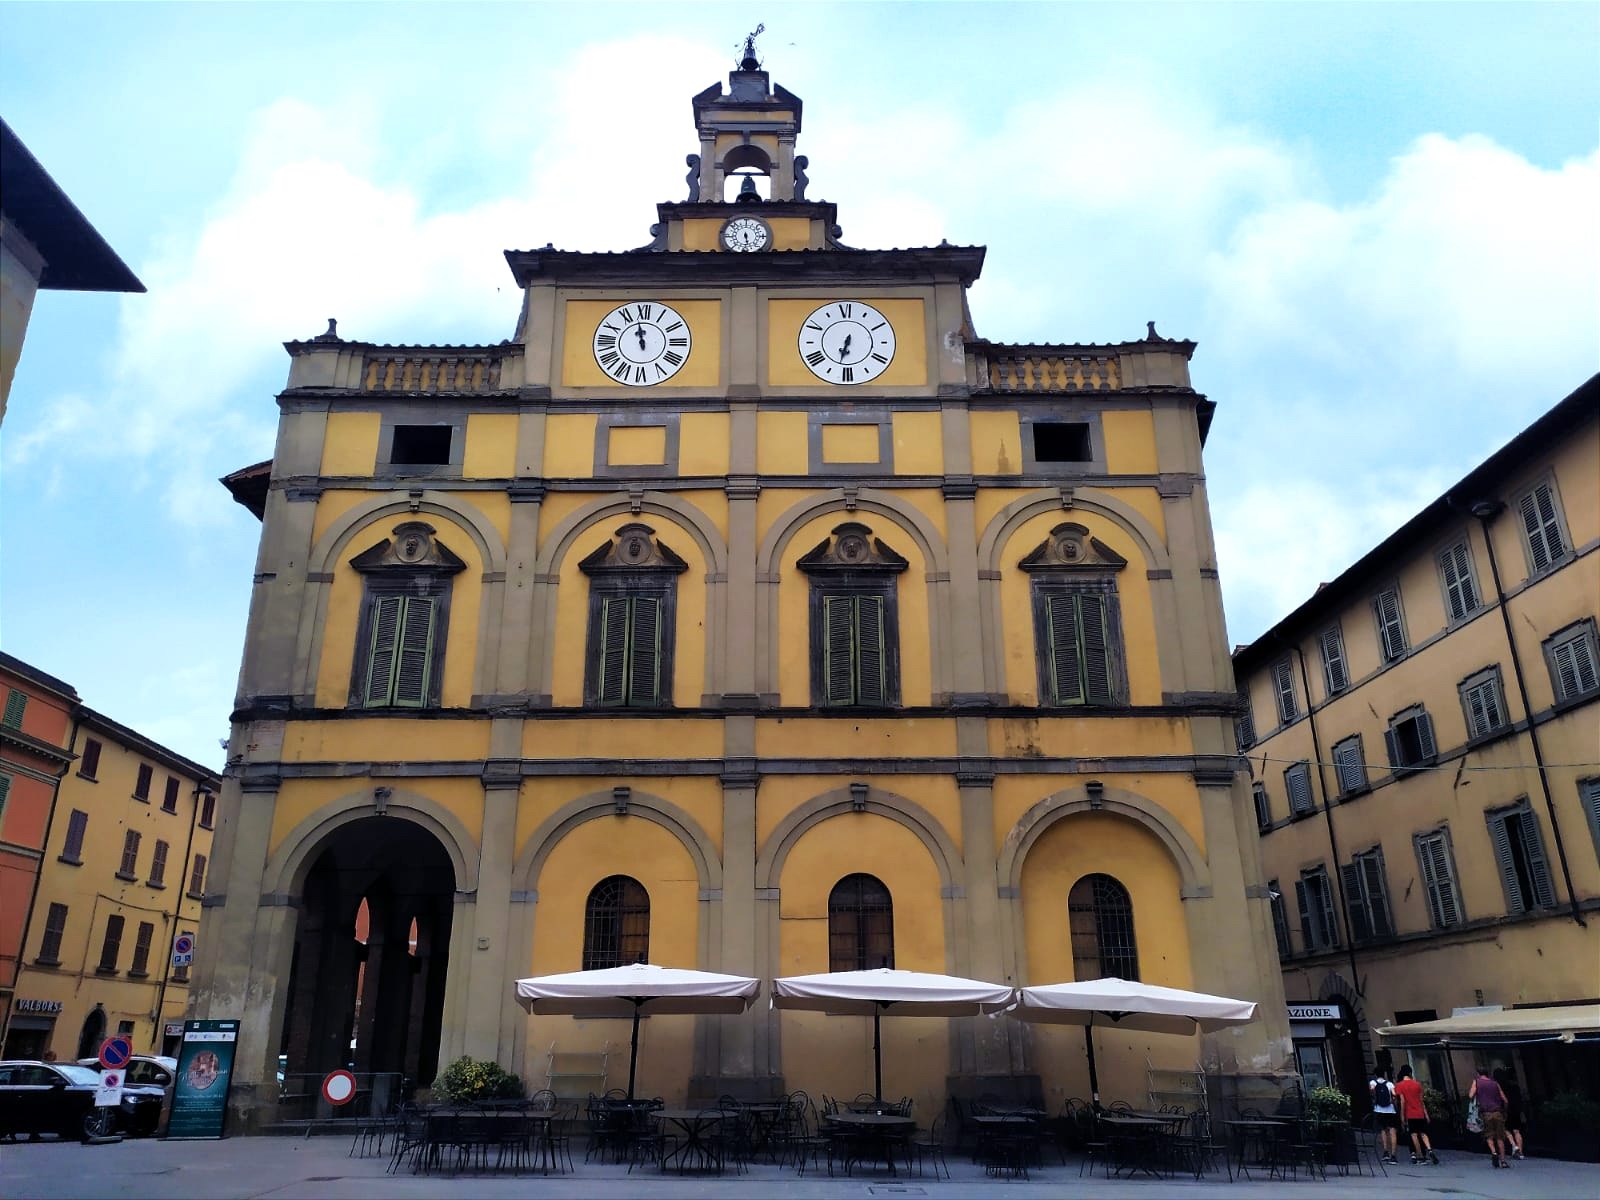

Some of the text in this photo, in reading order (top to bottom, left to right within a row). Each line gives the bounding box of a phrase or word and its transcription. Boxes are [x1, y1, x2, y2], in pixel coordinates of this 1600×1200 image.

[637, 305, 651, 320] XII
[839, 304, 851, 319] VI
[806, 320, 823, 331] V
[669, 338, 687, 346] III
[635, 366, 646, 383] VI
[655, 363, 667, 379] V
[842, 367, 854, 382] III
